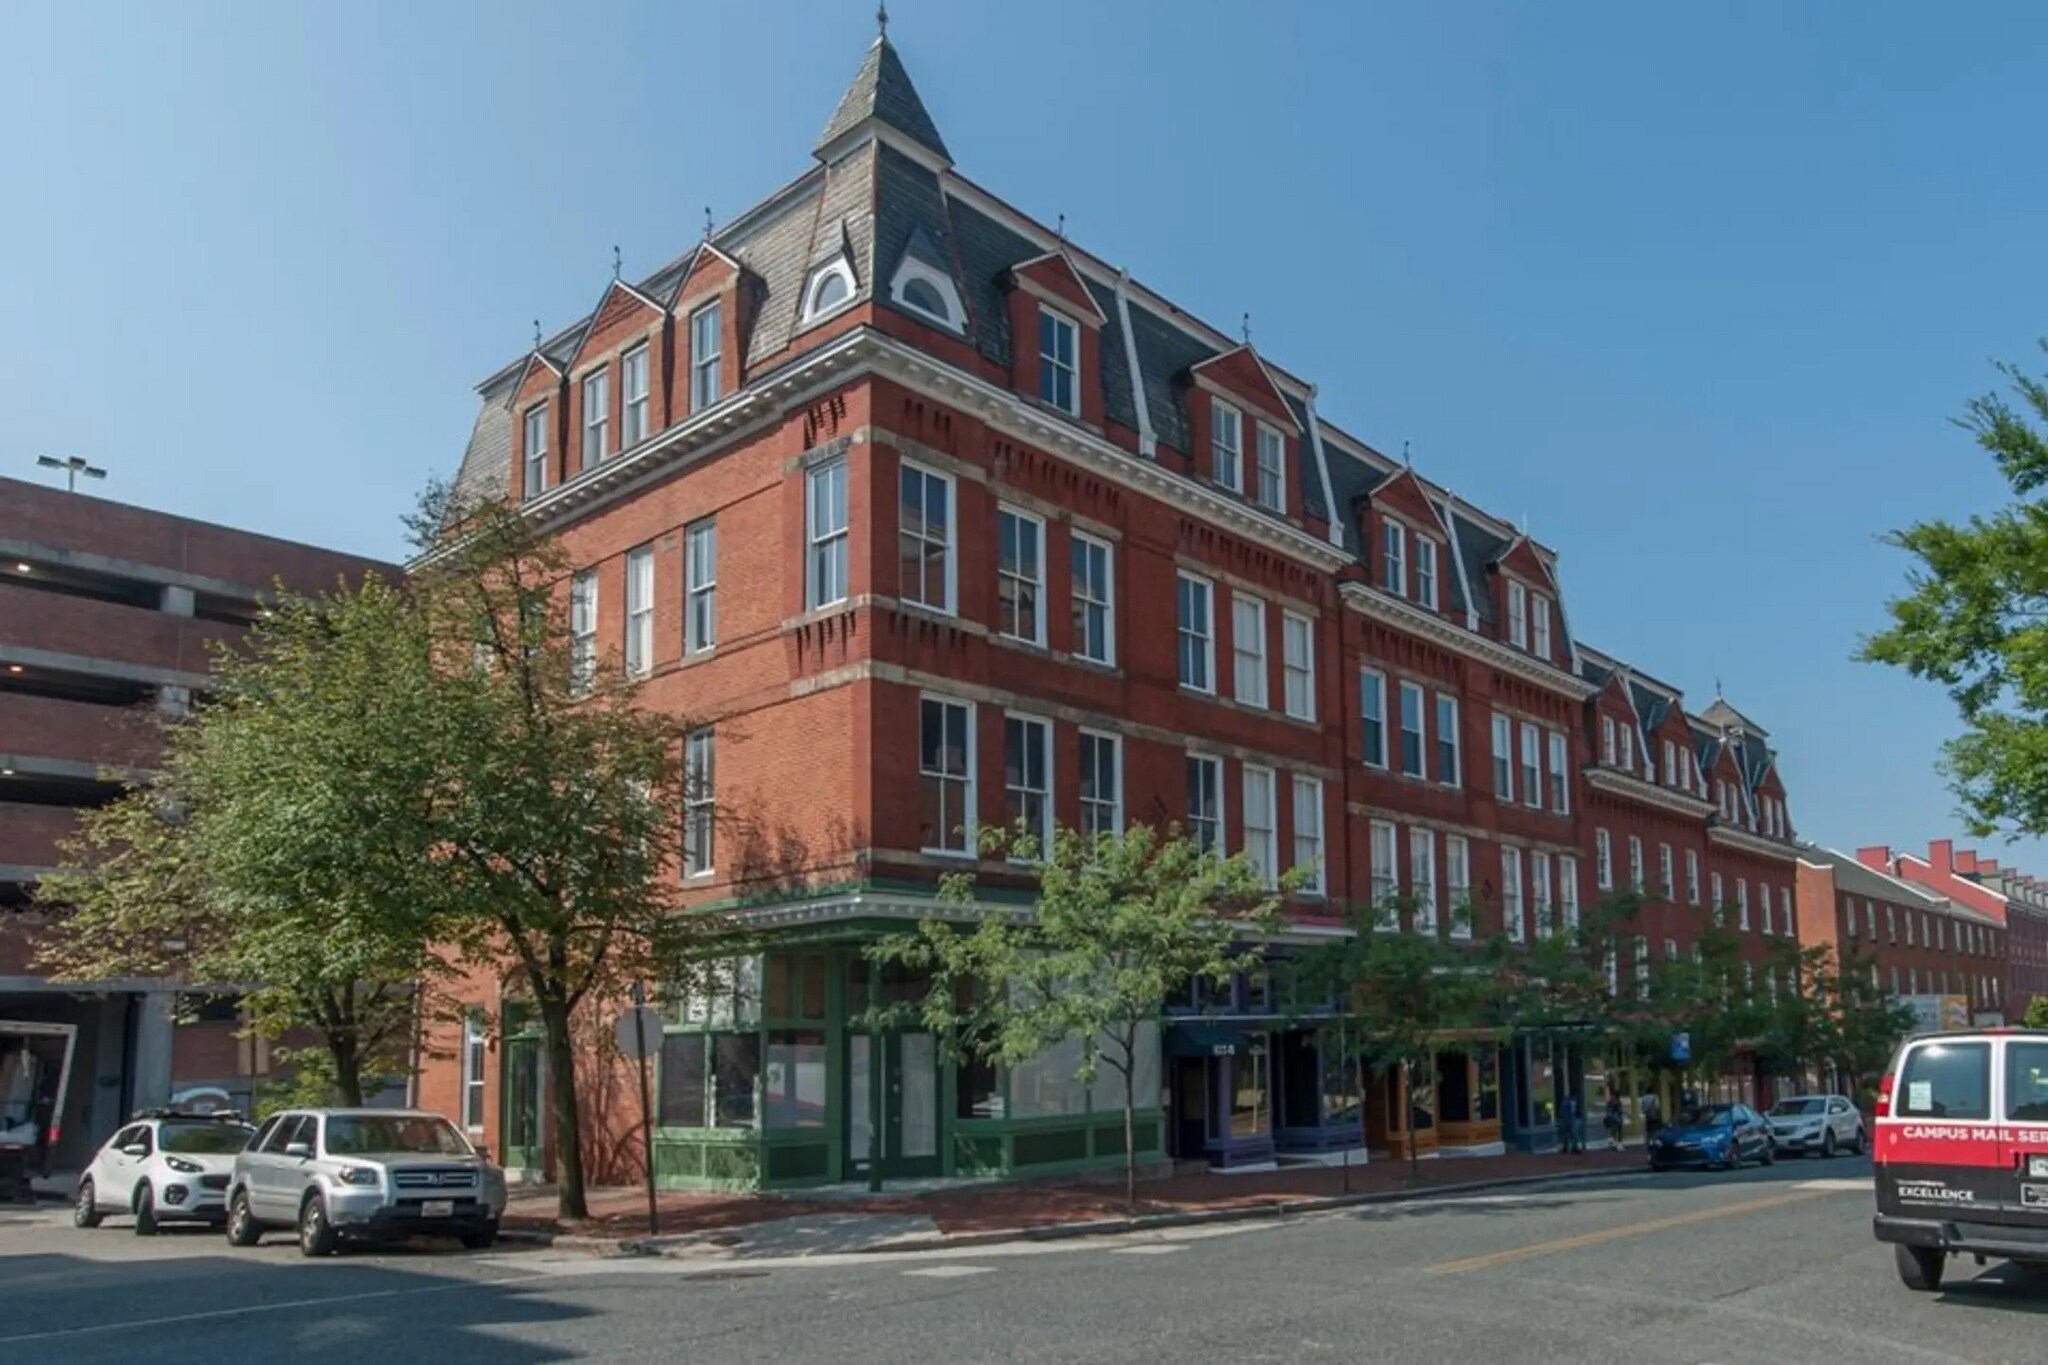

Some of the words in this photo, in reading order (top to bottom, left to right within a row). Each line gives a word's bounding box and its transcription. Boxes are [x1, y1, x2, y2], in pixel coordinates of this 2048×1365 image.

[1902, 1126, 1969, 1140] CAMPUS
[1972, 1129, 2014, 1142] MAIL
[1898, 1186, 1974, 1201] EXCELLENCE
